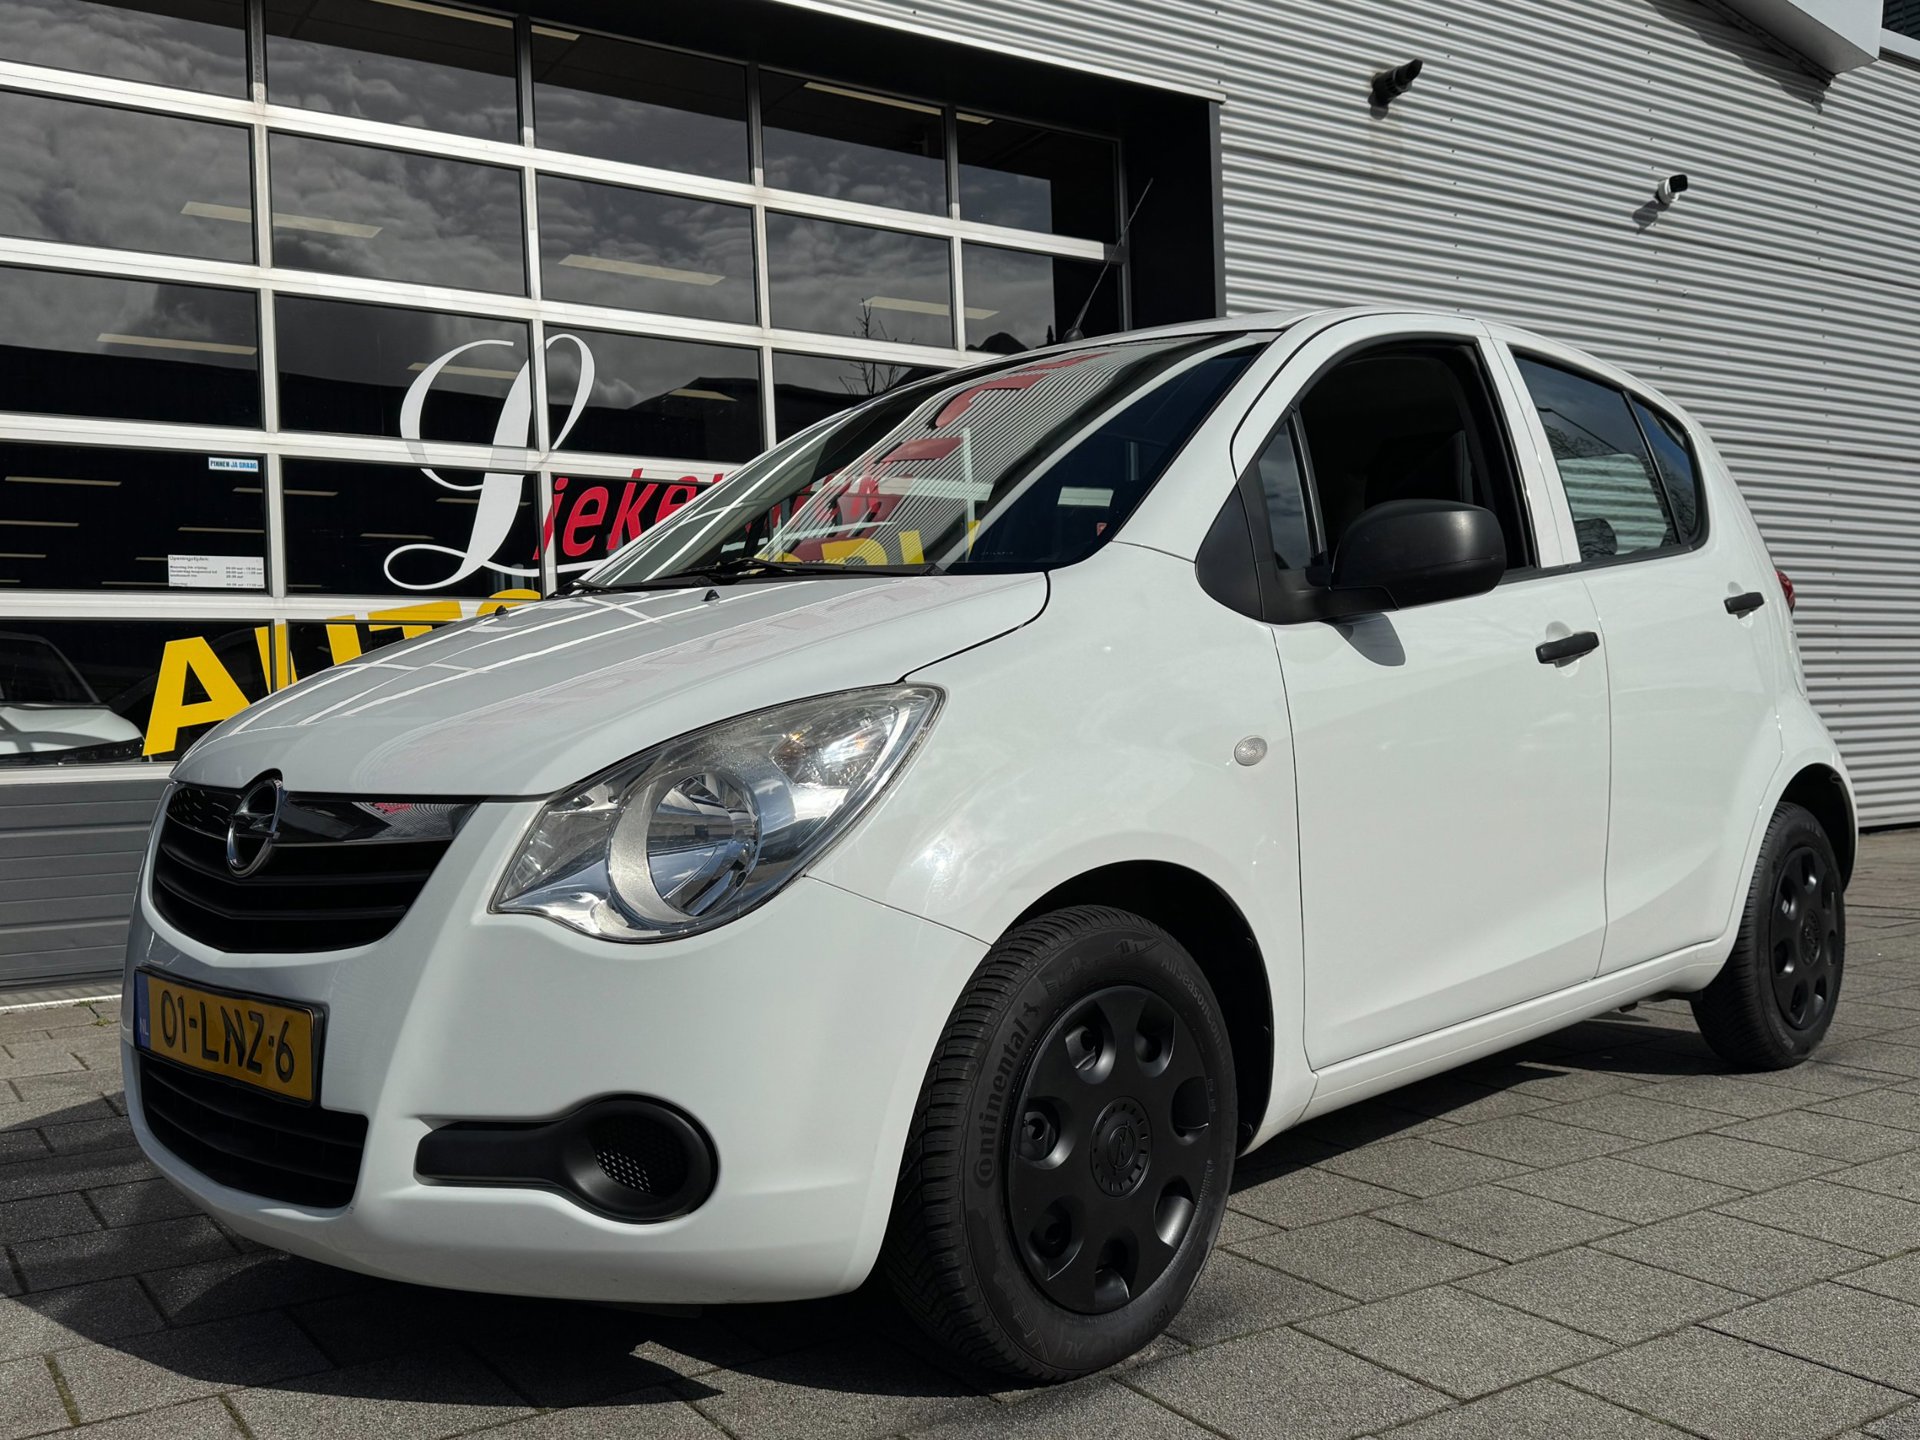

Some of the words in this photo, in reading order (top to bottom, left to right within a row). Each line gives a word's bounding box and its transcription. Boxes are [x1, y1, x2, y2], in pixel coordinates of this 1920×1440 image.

[210, 460, 230, 468] PINNEN
[139, 1017, 149, 1036] NL
[973, 1014, 1031, 1190] Continental
